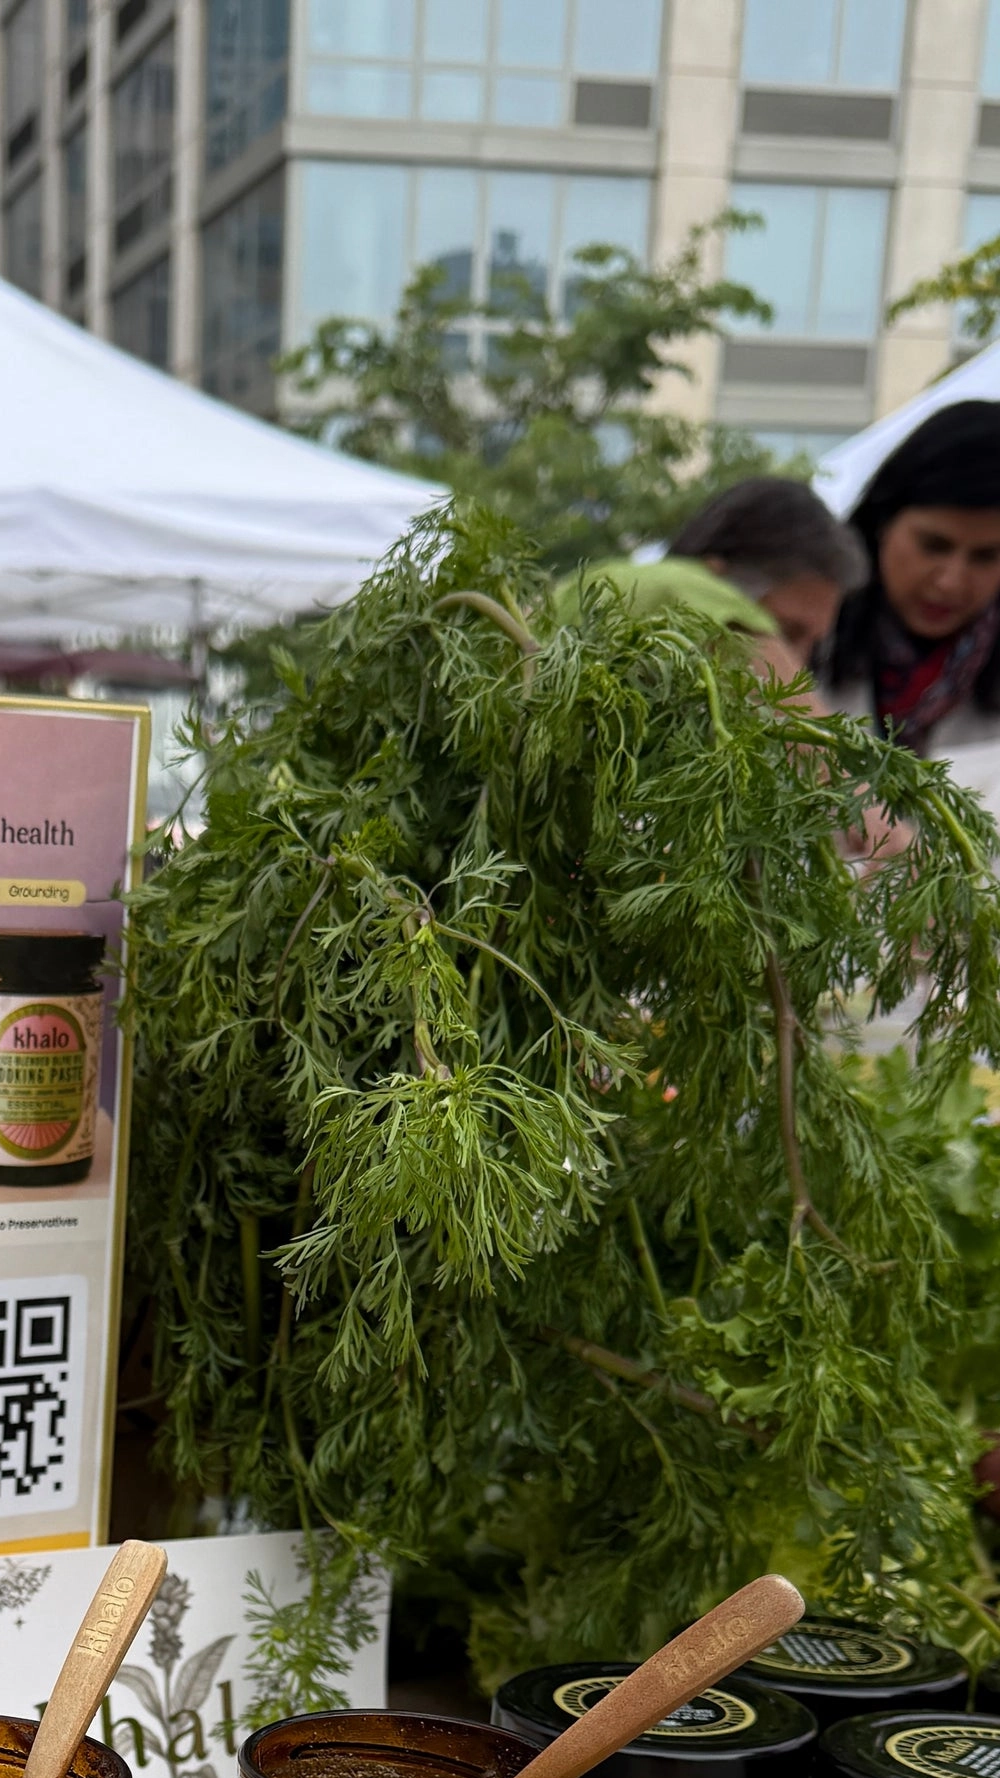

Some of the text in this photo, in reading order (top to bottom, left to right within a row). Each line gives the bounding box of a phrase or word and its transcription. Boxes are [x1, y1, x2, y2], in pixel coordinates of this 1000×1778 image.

[1, 818, 75, 847] health
[9, 884, 70, 903] Grounding
[13, 1026, 69, 1049] khalo
[8, 1216, 79, 1230] Preservatives
[76, 1575, 136, 1657] khalo
[653, 1615, 750, 1687] khalo
